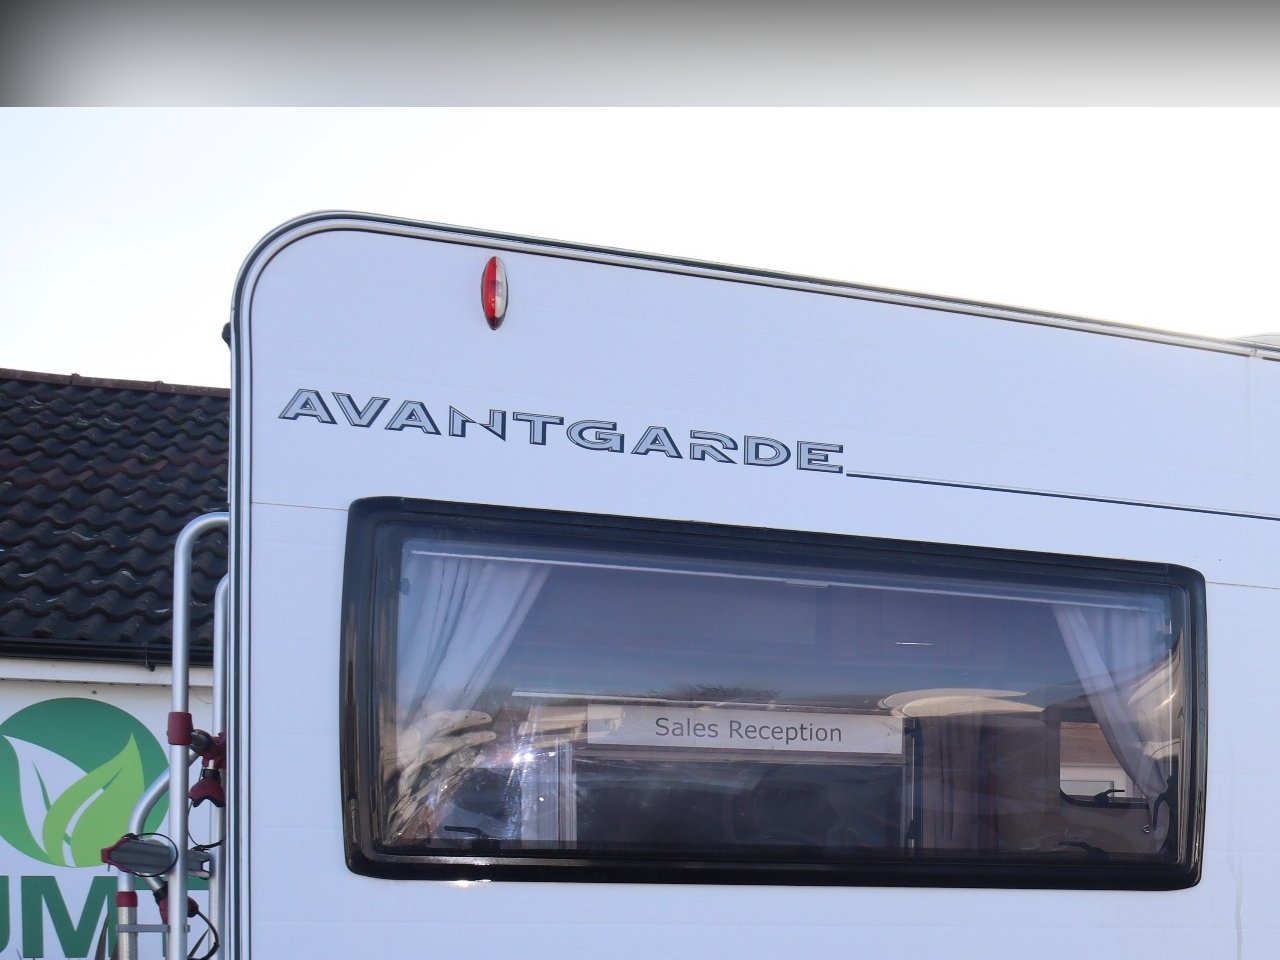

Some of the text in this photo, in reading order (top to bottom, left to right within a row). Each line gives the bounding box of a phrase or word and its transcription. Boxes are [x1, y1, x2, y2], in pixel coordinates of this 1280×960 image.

[279, 388, 844, 474] AVANTGARDE
[655, 717, 842, 745] Sales Reception
